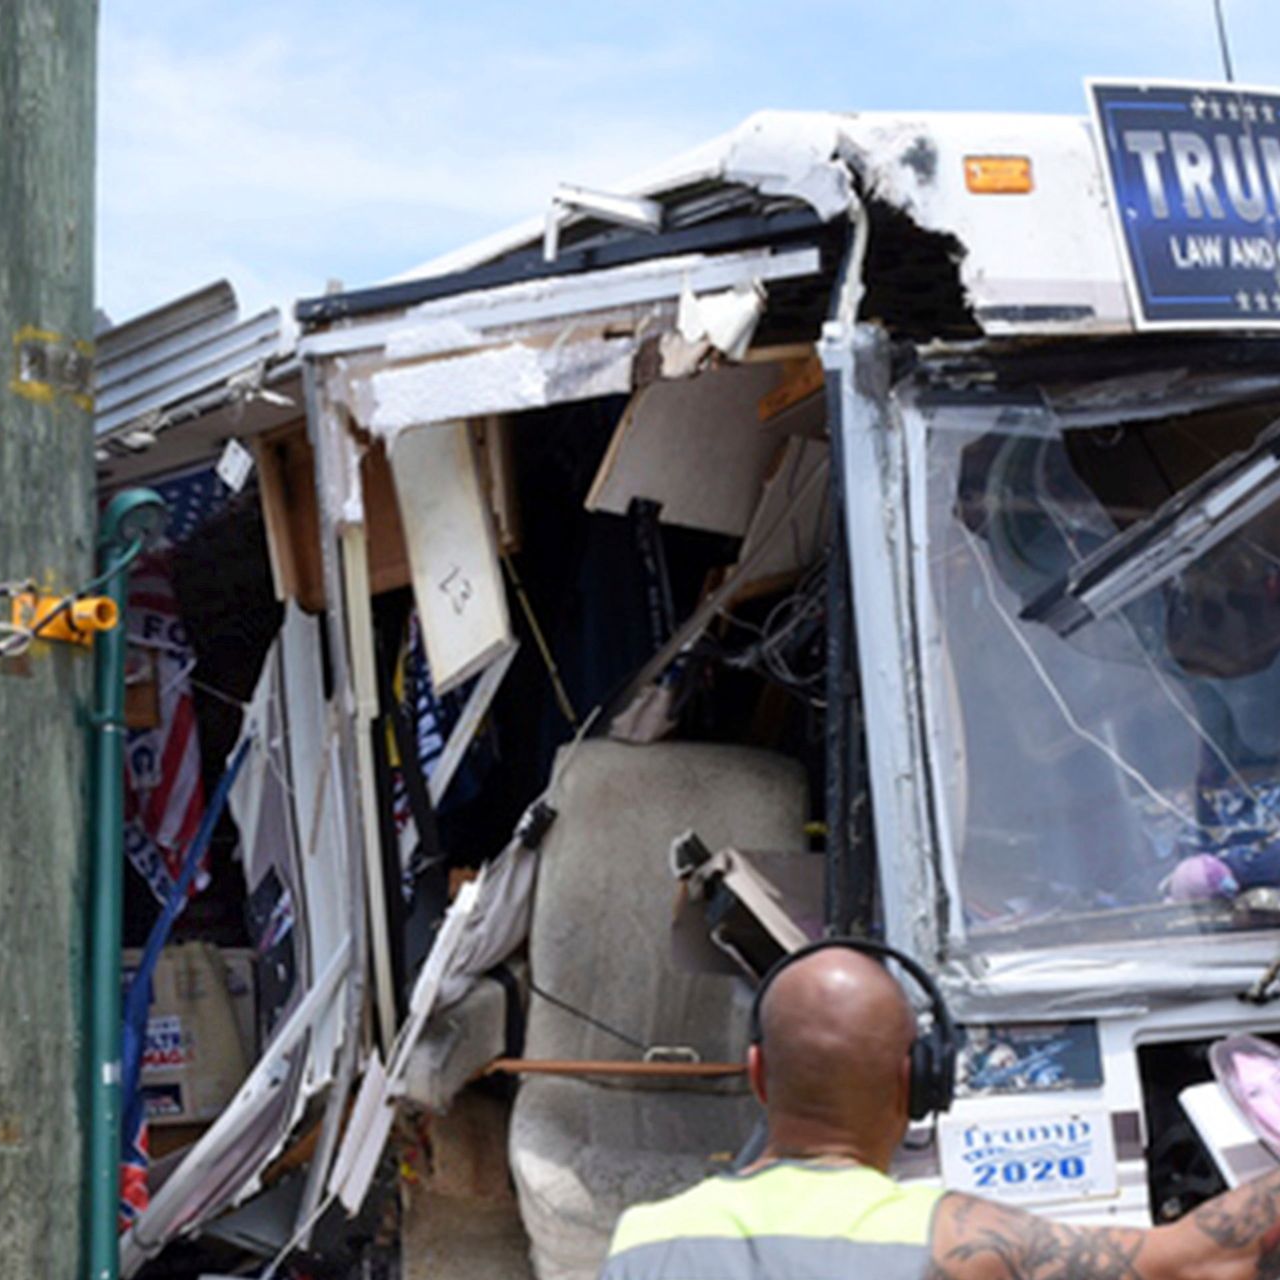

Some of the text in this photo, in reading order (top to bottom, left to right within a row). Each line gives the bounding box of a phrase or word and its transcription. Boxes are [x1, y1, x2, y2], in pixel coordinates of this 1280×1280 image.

[1170, 235, 1222, 269] LAW
[1228, 236, 1275, 271] AND
[972, 1155, 1086, 1188] 2020
